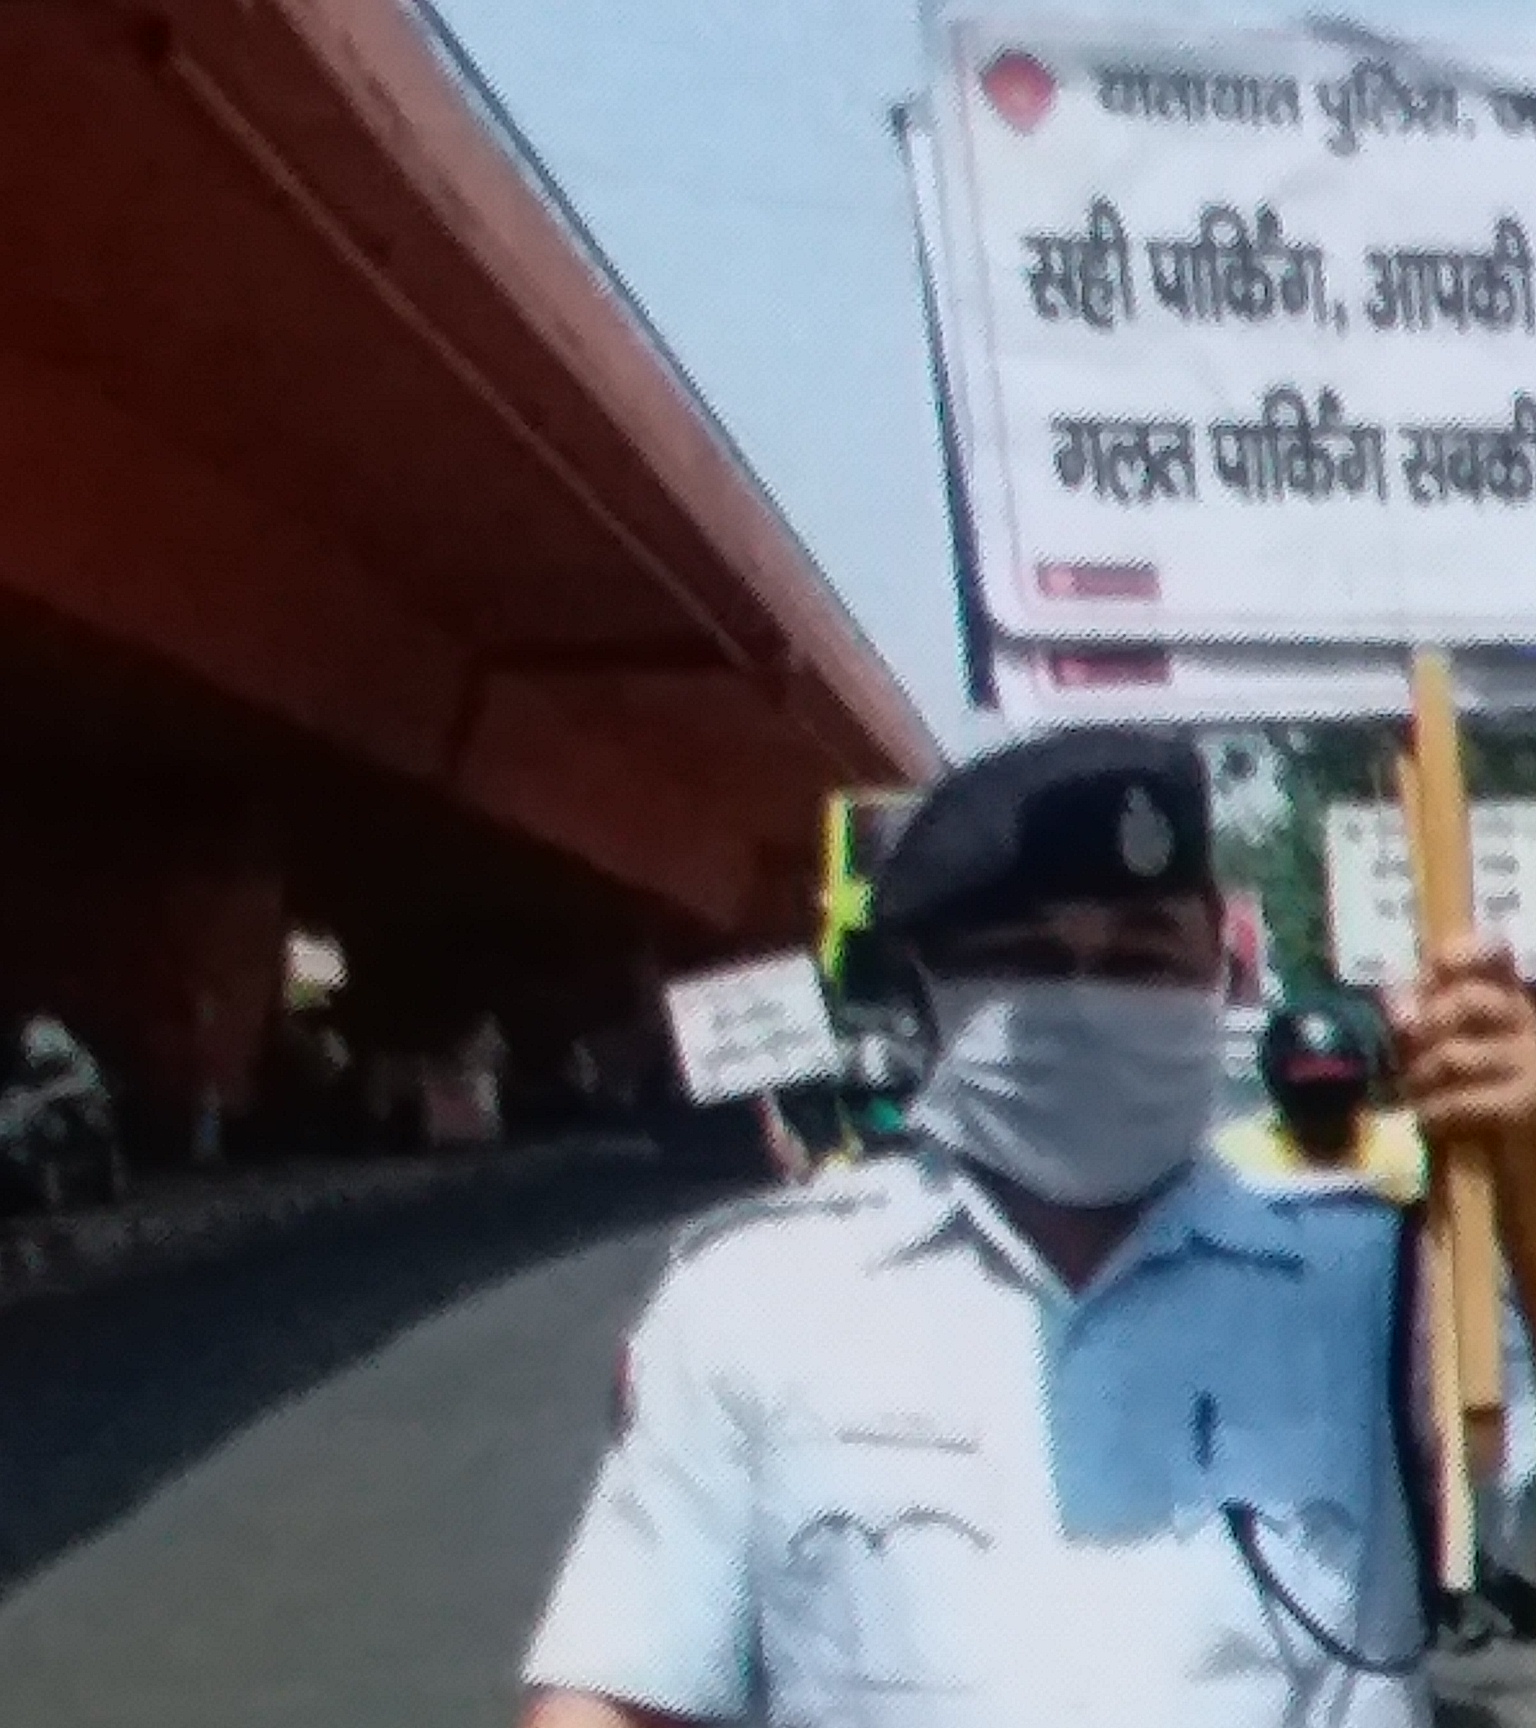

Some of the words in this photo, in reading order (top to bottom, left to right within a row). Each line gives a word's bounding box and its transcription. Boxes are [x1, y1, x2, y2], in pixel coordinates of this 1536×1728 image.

[1022, 198, 1140, 331] सही
[1146, 203, 1349, 339] पार्किंग,
[1364, 217, 1535, 335] आपकी
[1050, 414, 1197, 506] गलत
[1207, 385, 1386, 505] पार्किंग
